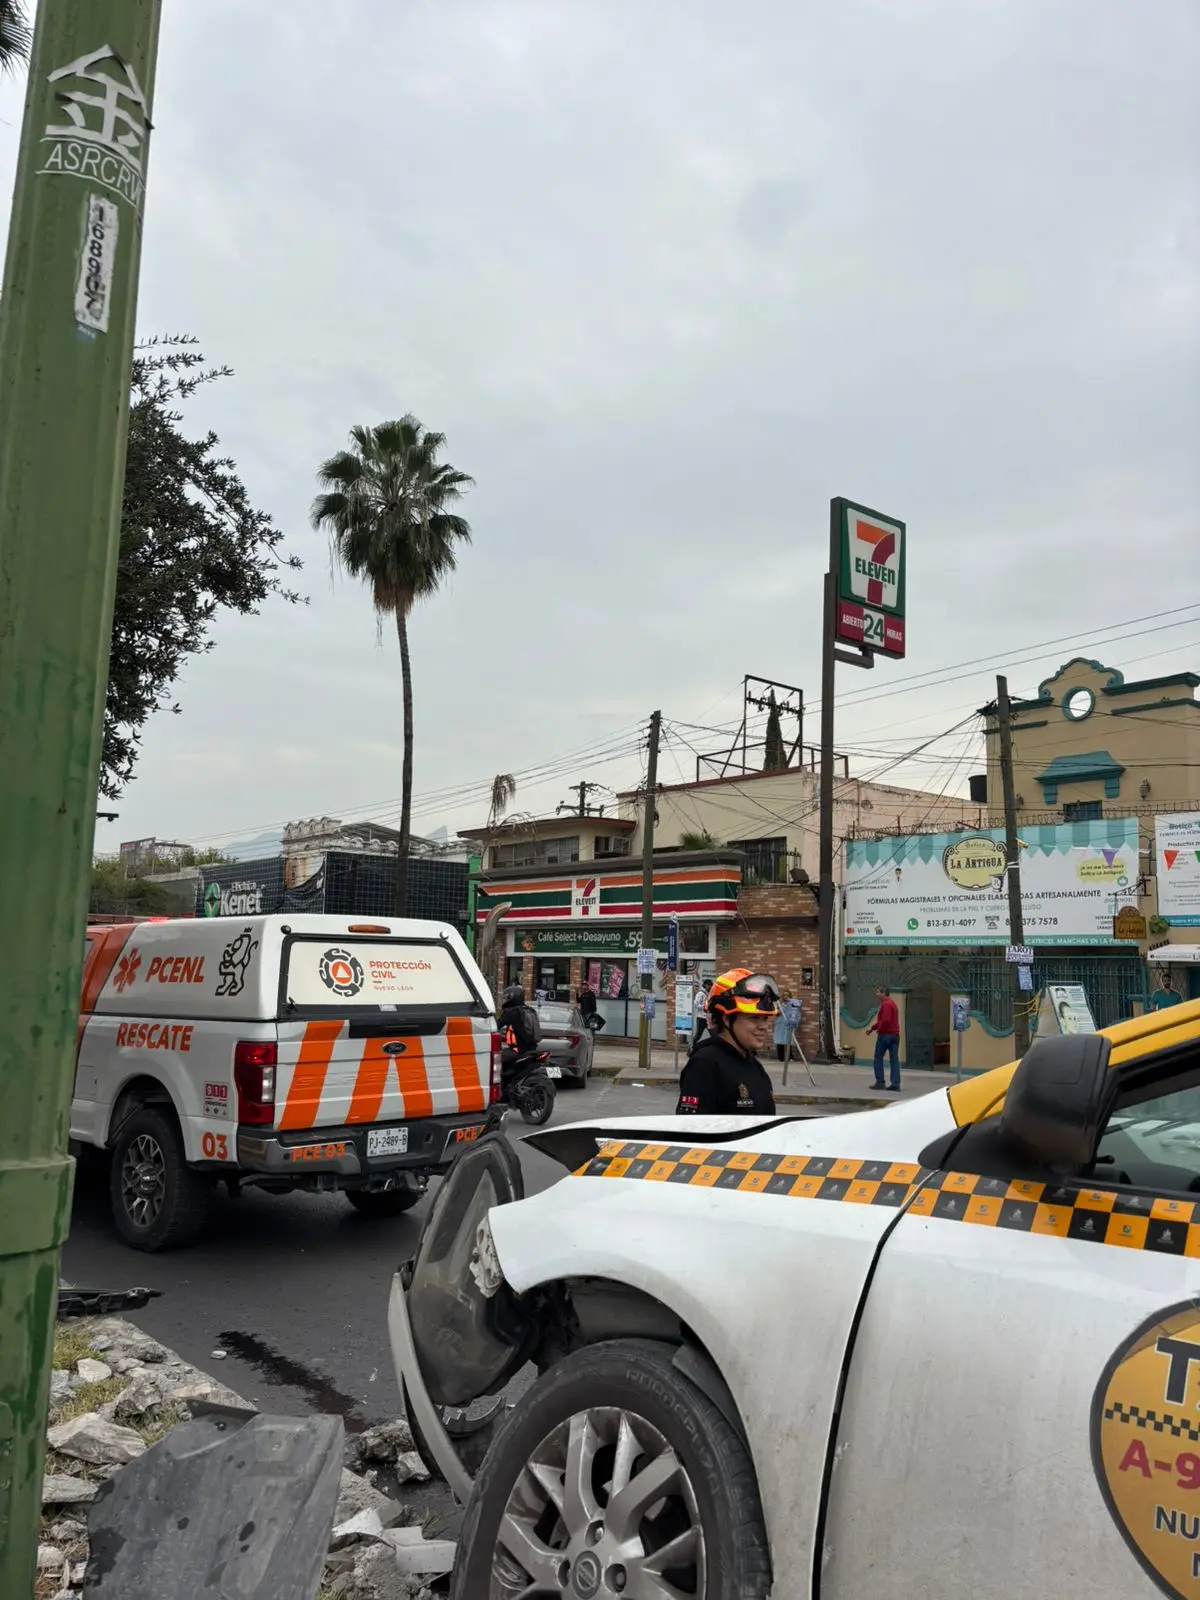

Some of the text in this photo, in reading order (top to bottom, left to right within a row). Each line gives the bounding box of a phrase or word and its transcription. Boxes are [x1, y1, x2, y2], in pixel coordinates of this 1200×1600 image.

[842, 613, 864, 630] ABIERTO
[863, 612, 884, 642] 24
[220, 888, 264, 916] Kenet
[867, 897, 898, 905] FÓRMULAS
[899, 895, 941, 904] MAGISTRALES
[948, 893, 986, 902] OFICINALES
[988, 891, 1033, 901] ELABODAS
[1035, 889, 1101, 899] ARTESANALMENTE
[926, 918, 977, 927] 813-871-4097
[1038, 917, 1059, 926] 7578
[537, 931, 553, 942] Café
[554, 931, 577, 942] Select
[583, 931, 621, 944] Desayuno
[1008, 945, 1033, 954] TAROT
[145, 956, 205, 984] PCENL
[369, 960, 432, 970] PROTECCIÓN
[371, 970, 397, 979] CIVIL
[115, 1022, 195, 1052] RESCATE
[206, 1084, 227, 1098] 911
[455, 1128, 477, 1145] PCE
[201, 1131, 228, 1160] 03
[291, 1143, 346, 1163] PCE 03
[1155, 1335, 1200, 1406] T
